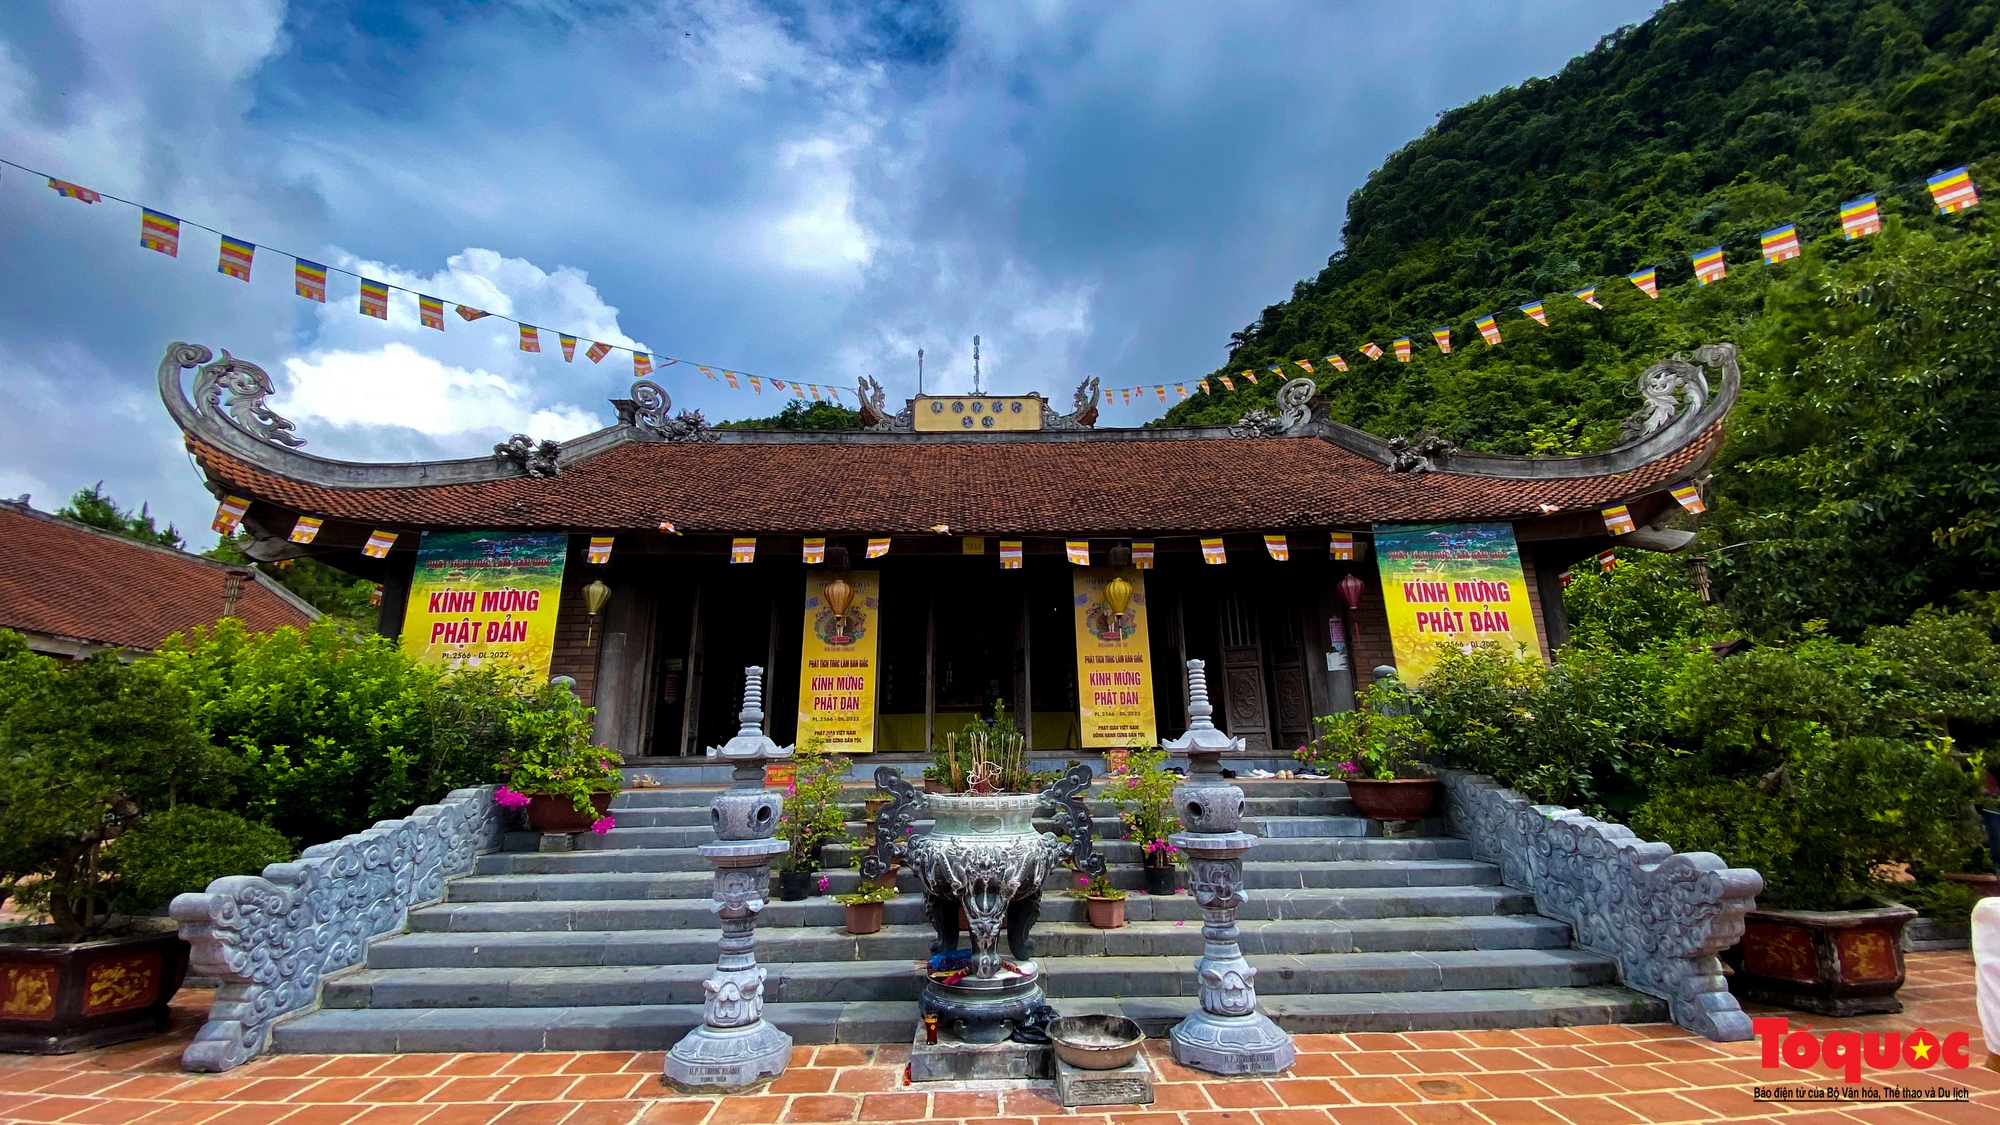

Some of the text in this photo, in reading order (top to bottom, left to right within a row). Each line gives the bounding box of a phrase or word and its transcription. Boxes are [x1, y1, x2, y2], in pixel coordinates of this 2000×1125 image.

[428, 586, 540, 613] KÍNH MỪNG
[1403, 577, 1511, 602] KÍNH MỪNG
[430, 613, 528, 648] PHẬT ĐẢN
[1416, 604, 1511, 637] PHẬT ĐẢN
[811, 673, 864, 691] KÍNH MỪNG
[1089, 669, 1141, 686] KÍNH MỪNG
[814, 691, 859, 713] PHẬT ĐẢN
[1094, 687, 1139, 709] PHẬT ĐẢN
